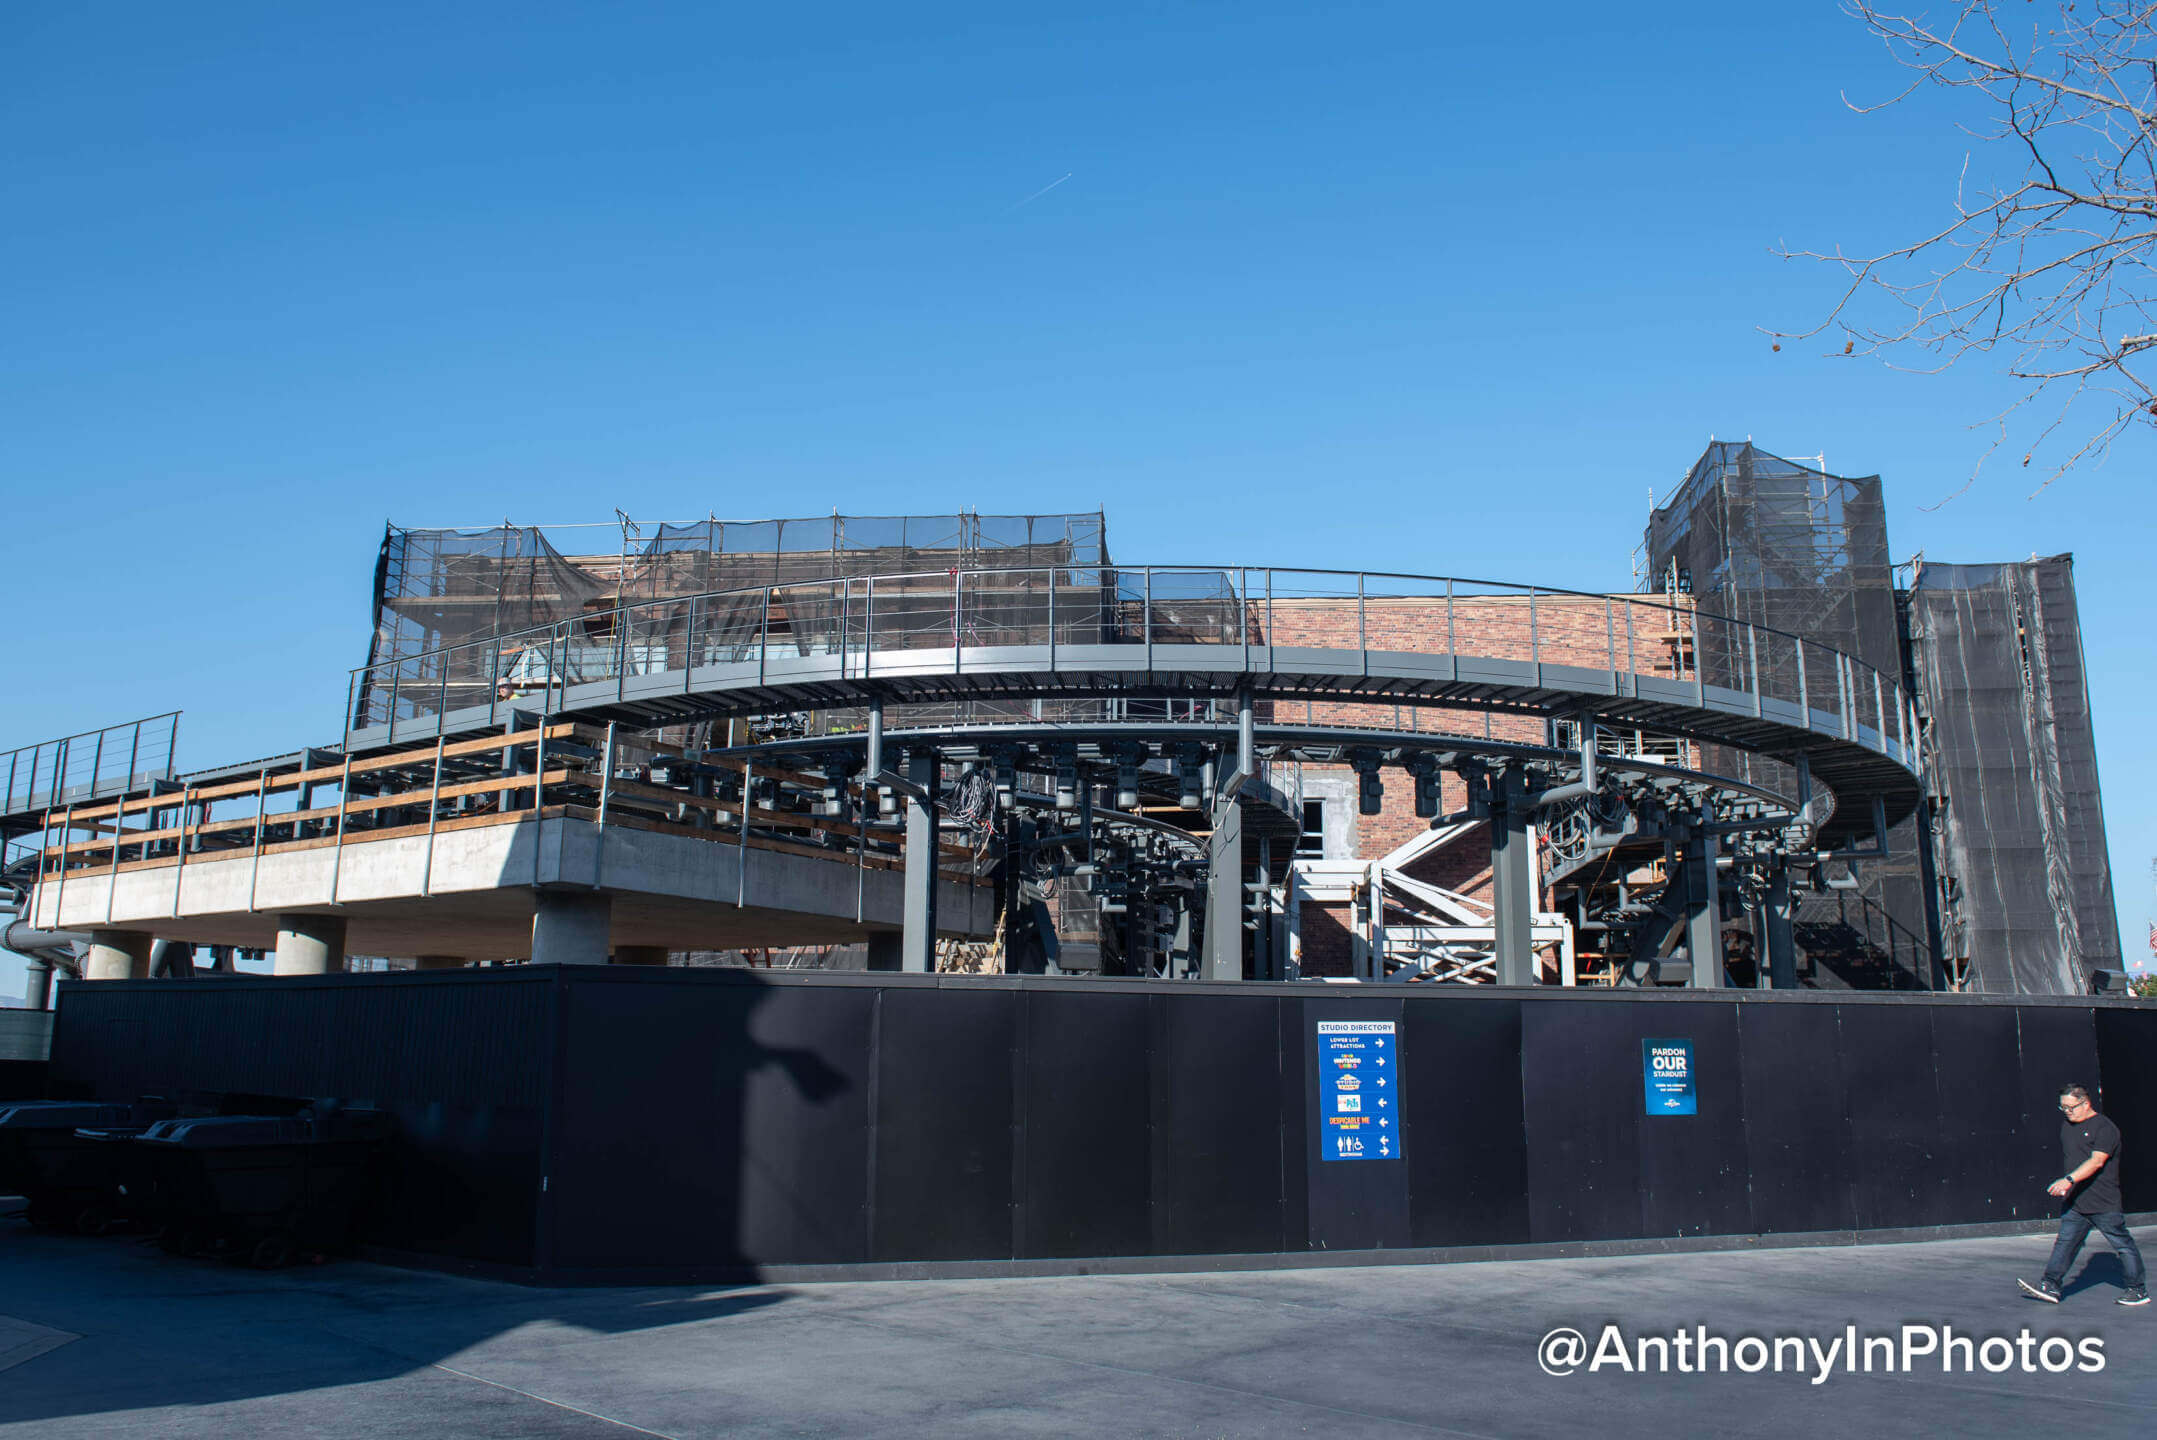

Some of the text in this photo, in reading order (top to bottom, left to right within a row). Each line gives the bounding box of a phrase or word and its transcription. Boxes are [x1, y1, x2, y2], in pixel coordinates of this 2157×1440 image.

[1652, 1048, 1686, 1056] PARDON
[1652, 1056, 1687, 1070] OUR
[1653, 1070, 1687, 1078] STARDUST
